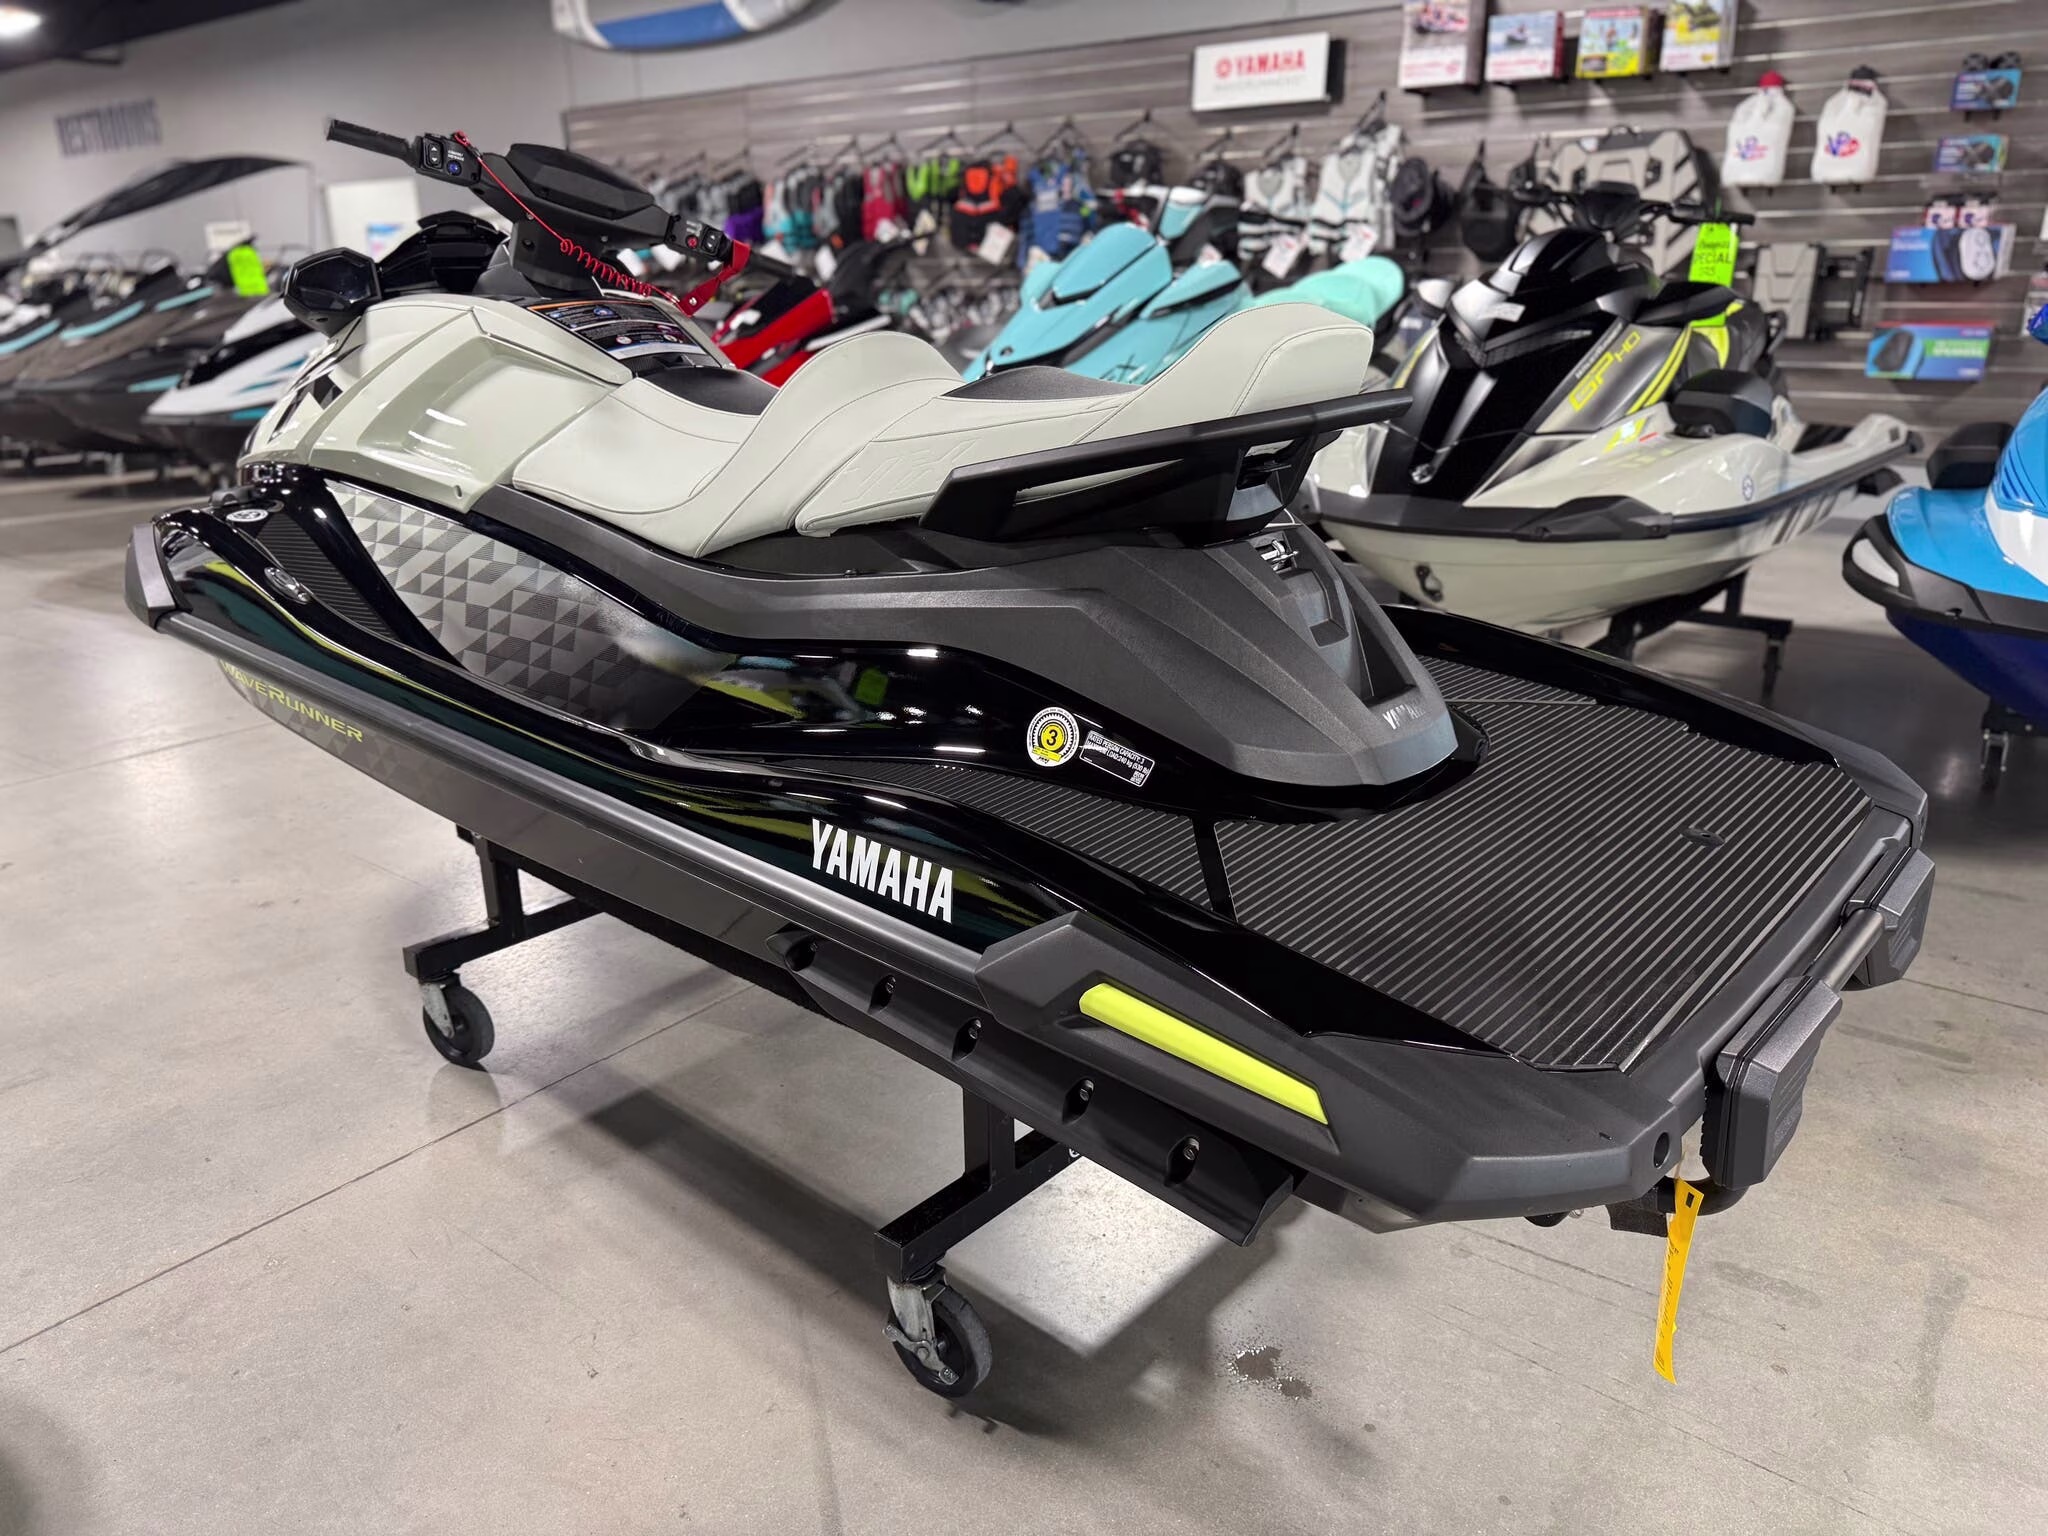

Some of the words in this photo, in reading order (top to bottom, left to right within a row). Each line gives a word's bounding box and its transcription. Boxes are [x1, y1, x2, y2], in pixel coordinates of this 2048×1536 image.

[1236, 50, 1305, 76] YAMAHA
[1046, 729, 1058, 746] 3
[812, 818, 953, 924] YAMAHA
